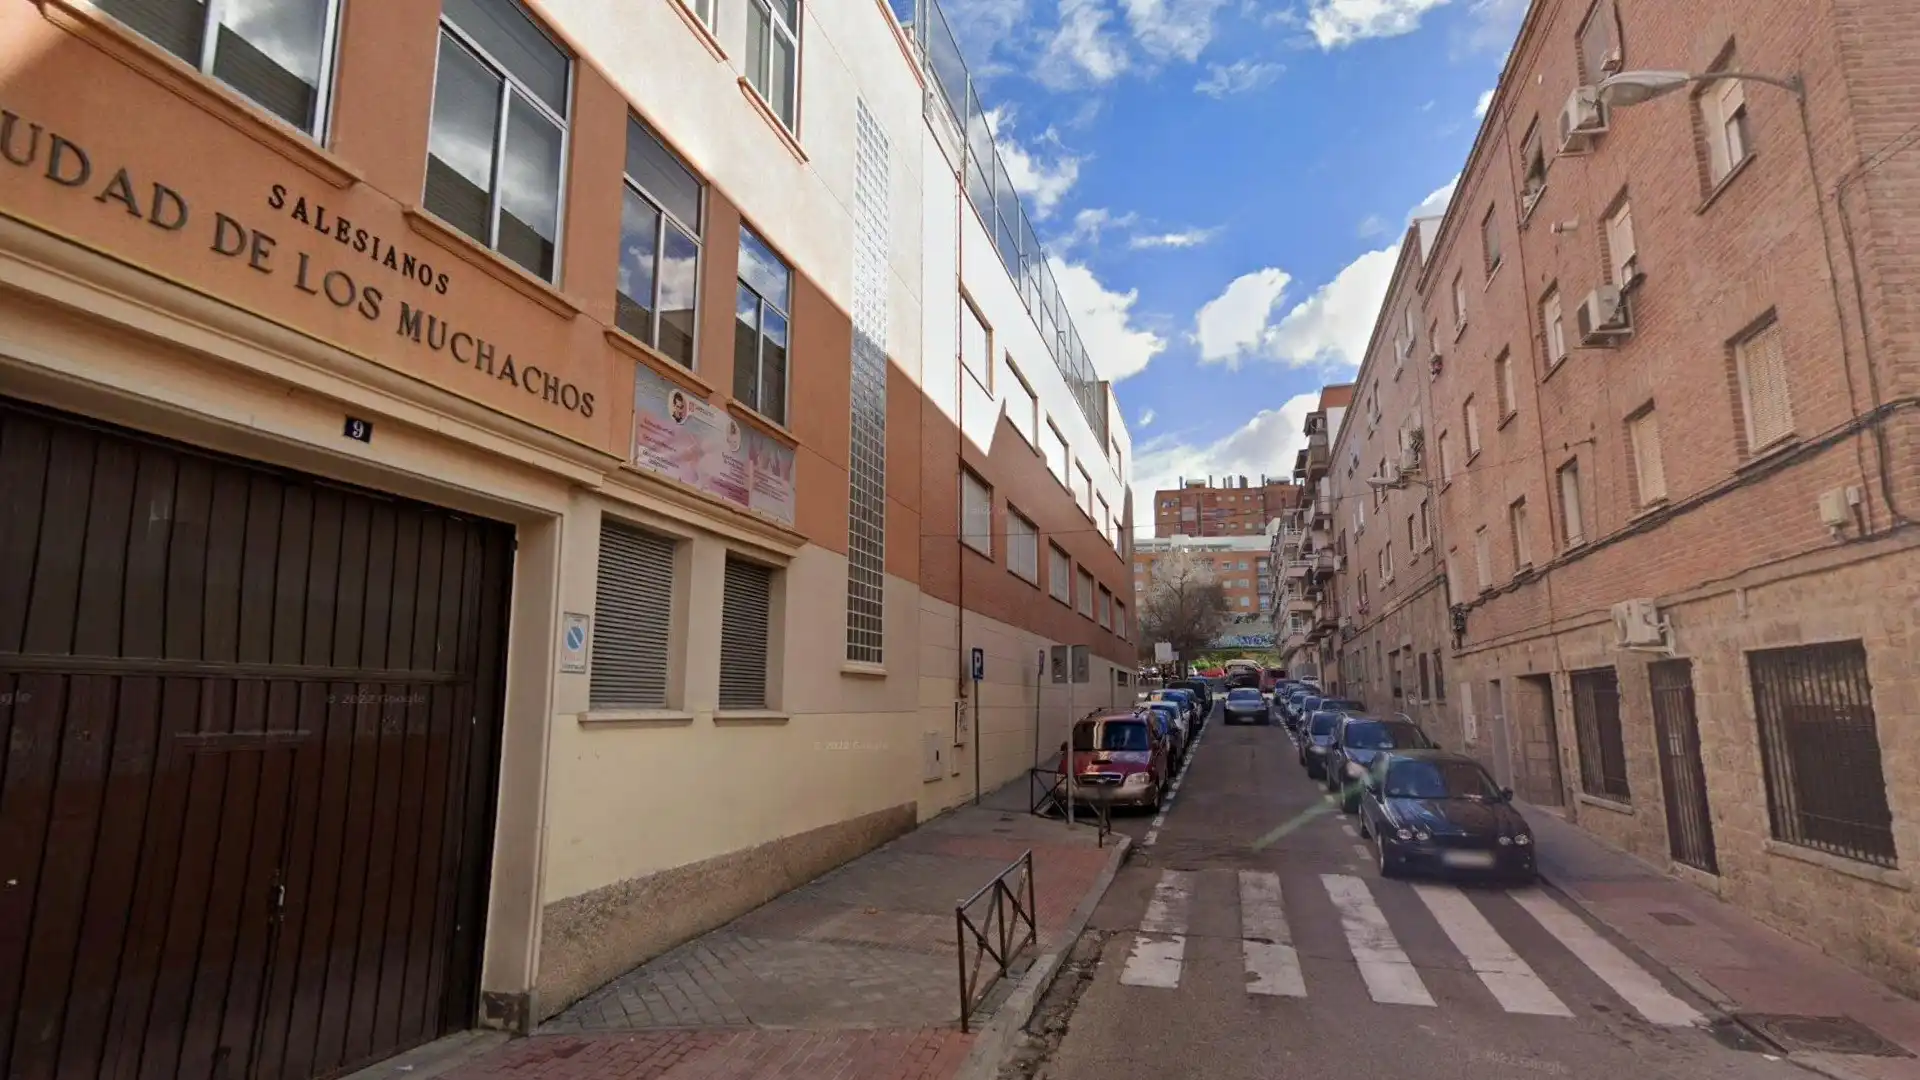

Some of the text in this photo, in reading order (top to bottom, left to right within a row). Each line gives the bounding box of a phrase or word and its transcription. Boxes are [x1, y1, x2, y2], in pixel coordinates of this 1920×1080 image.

[268, 184, 450, 295] SALESIANOS
[210, 211, 277, 275] DE
[294, 251, 383, 321] LOS
[396, 300, 595, 418] MUCHACHOS
[352, 420, 364, 438] 9
[973, 650, 982, 676] P
